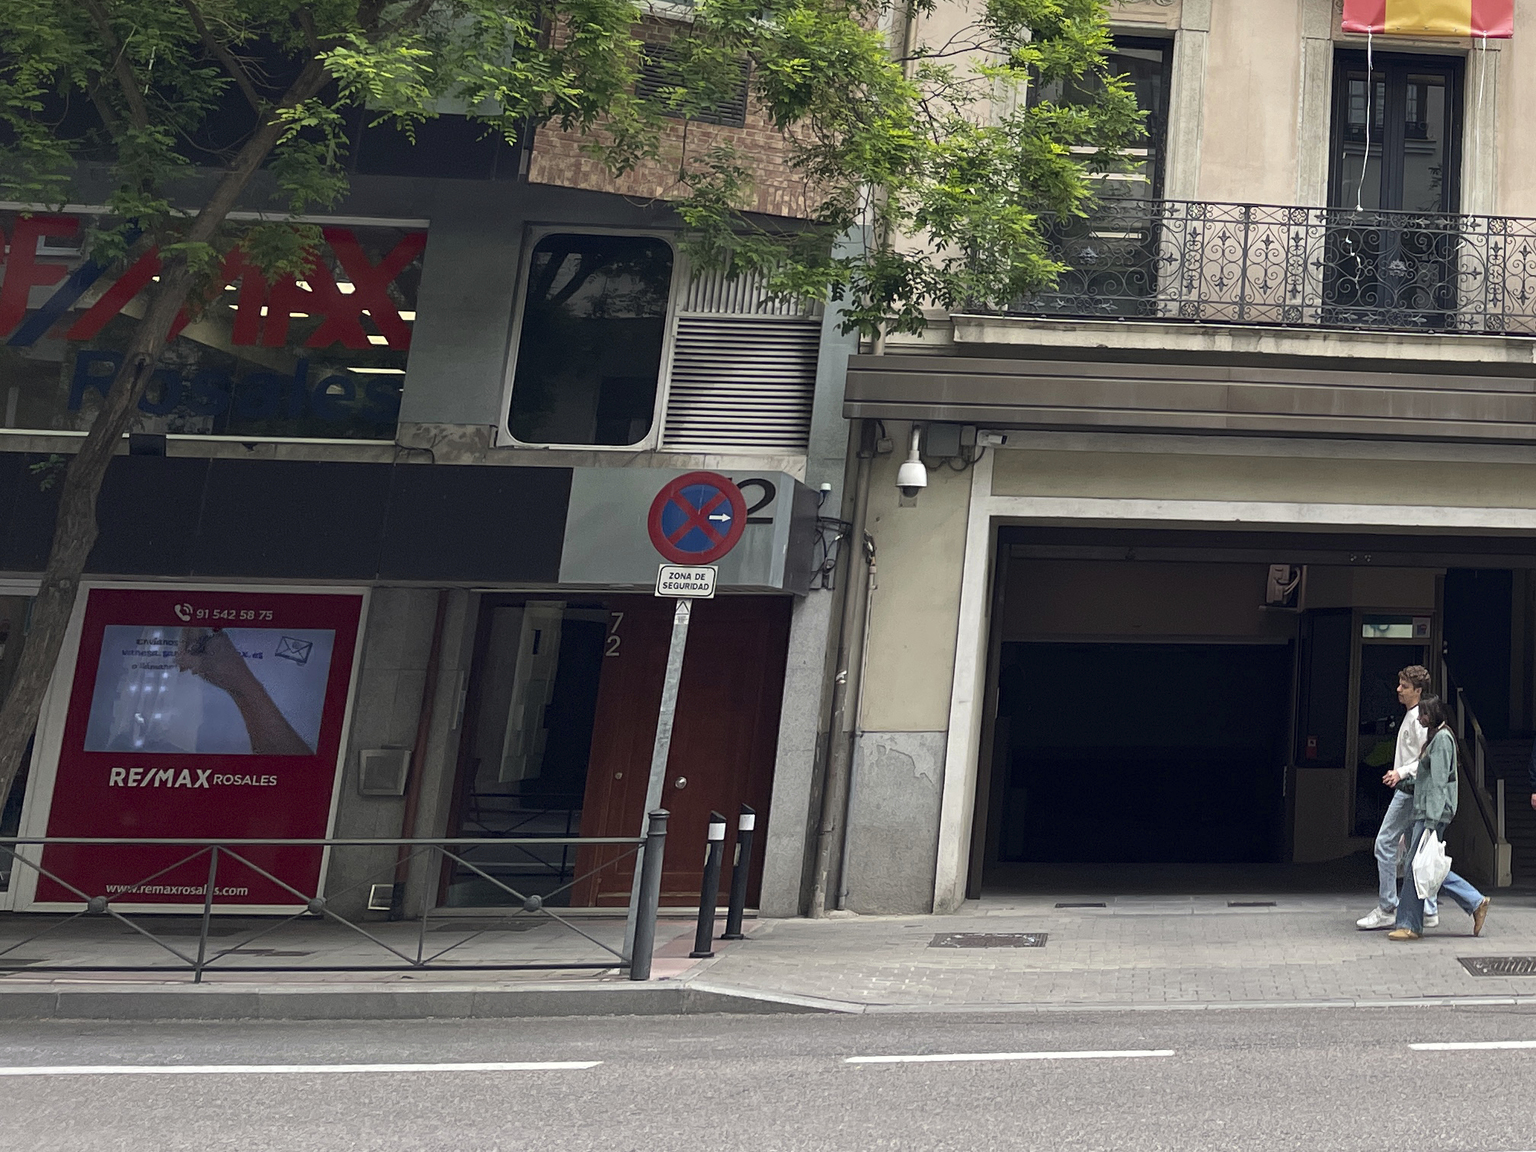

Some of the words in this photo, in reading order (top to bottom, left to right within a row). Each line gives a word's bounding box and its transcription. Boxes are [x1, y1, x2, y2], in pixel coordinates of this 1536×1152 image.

[0, 215, 428, 348] E/MAX
[67, 350, 403, 421] Rosales
[727, 477, 776, 524] 2
[668, 572, 692, 581] ZONA
[694, 573, 706, 581] DE
[662, 581, 710, 591] SEGURIDAD
[196, 609, 209, 619] 91
[212, 609, 236, 620] 542
[239, 610, 255, 620] 58
[258, 610, 273, 621] 75
[109, 767, 213, 789] RE/MAX
[213, 774, 278, 786] ROSALES
[105, 884, 249, 896] www.remaxrosals.com
